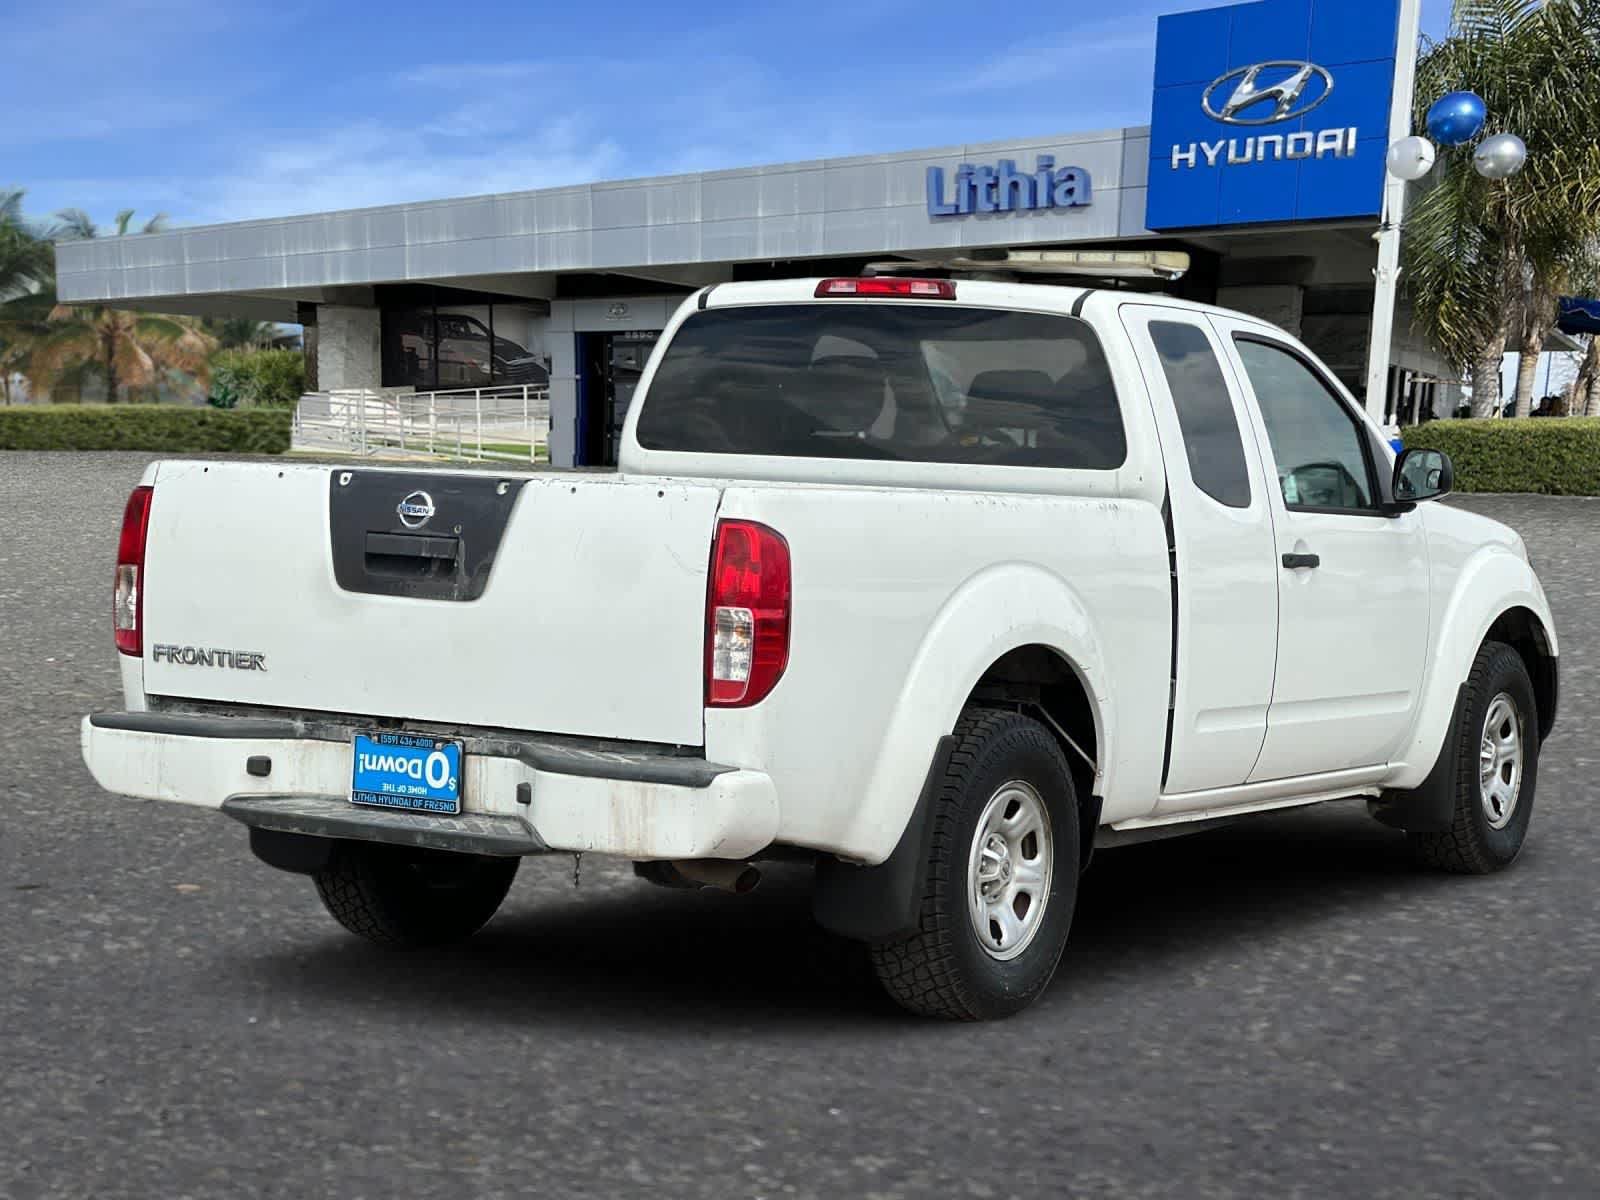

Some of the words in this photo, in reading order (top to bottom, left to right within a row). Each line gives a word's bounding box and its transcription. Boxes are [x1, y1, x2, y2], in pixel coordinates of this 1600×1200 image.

[1171, 127, 1357, 169] HYUNDAI
[926, 155, 1092, 215] Lithia
[400, 504, 430, 514] NISSAN
[153, 643, 267, 672] FRONTIER
[382, 783, 395, 791] THE
[397, 784, 407, 793] OF
[407, 785, 427, 794] HOME
[353, 793, 376, 801] LITHIA
[378, 795, 411, 807] HYUNDAI
[413, 799, 422, 808] OF
[424, 801, 455, 811] FRESNO
